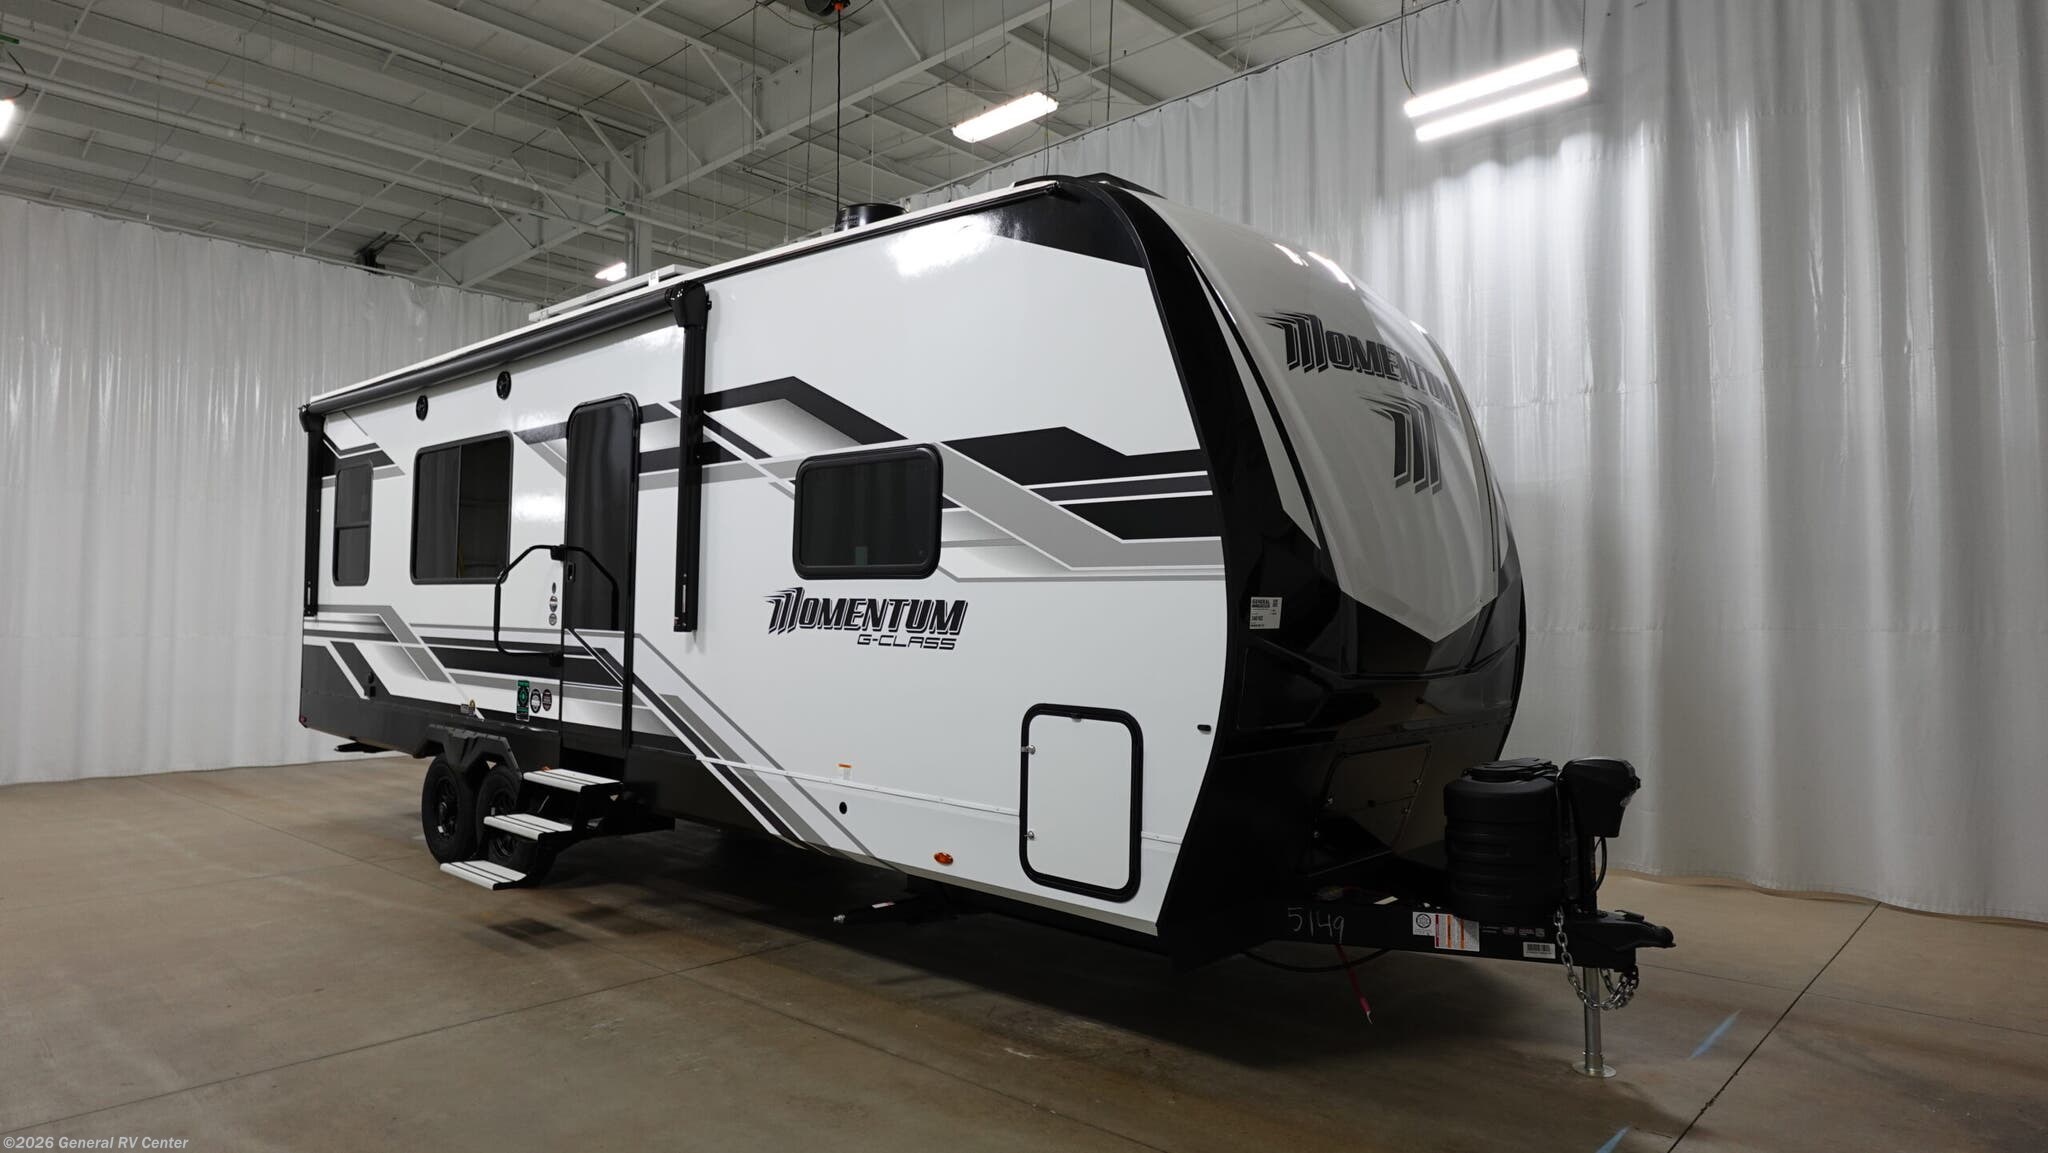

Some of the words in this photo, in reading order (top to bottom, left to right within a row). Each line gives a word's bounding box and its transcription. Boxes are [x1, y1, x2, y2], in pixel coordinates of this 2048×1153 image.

[1256, 310, 1458, 417] MOMENTUM
[763, 586, 969, 635] MOMENTUM
[857, 634, 957, 650] G-CLASS
[1288, 907, 1345, 944] 5149
